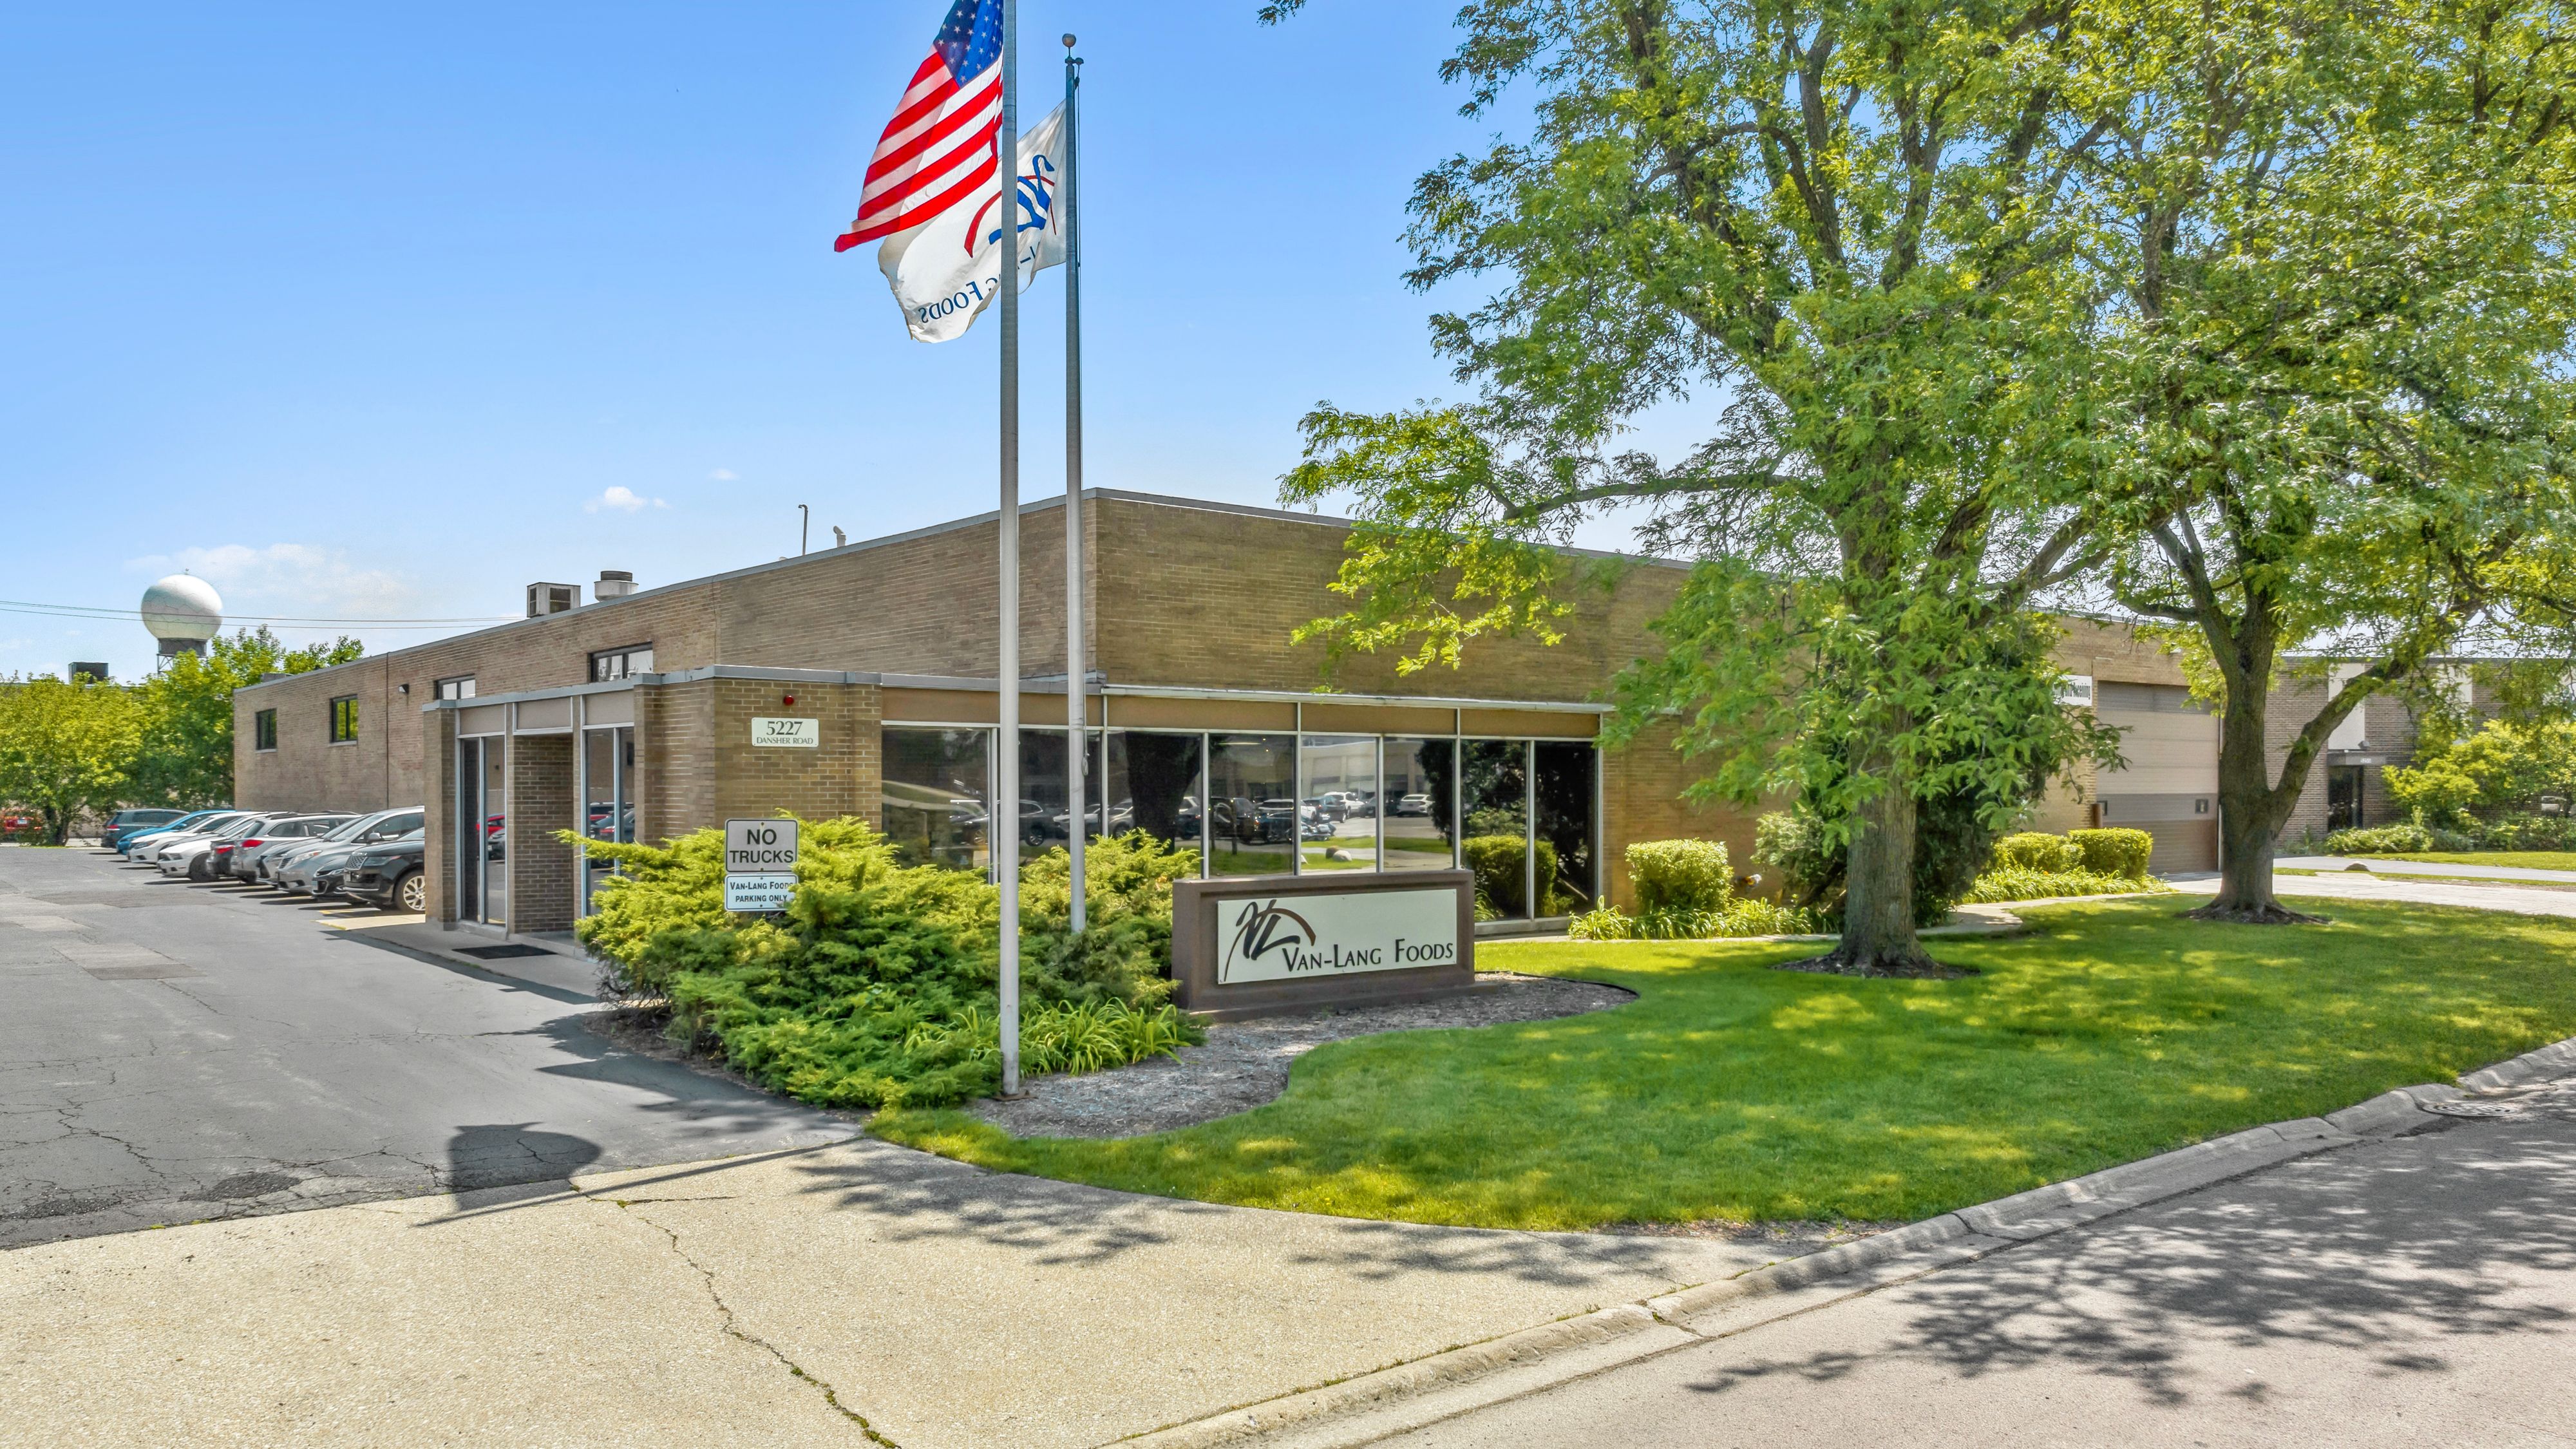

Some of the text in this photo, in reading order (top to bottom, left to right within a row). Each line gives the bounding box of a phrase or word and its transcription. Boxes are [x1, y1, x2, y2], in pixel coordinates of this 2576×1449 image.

[766, 721, 803, 735] 5227
[747, 829, 777, 845] NO
[729, 850, 793, 863] TRUCKS
[1282, 938, 1453, 972] VAN-LANG FOODS
